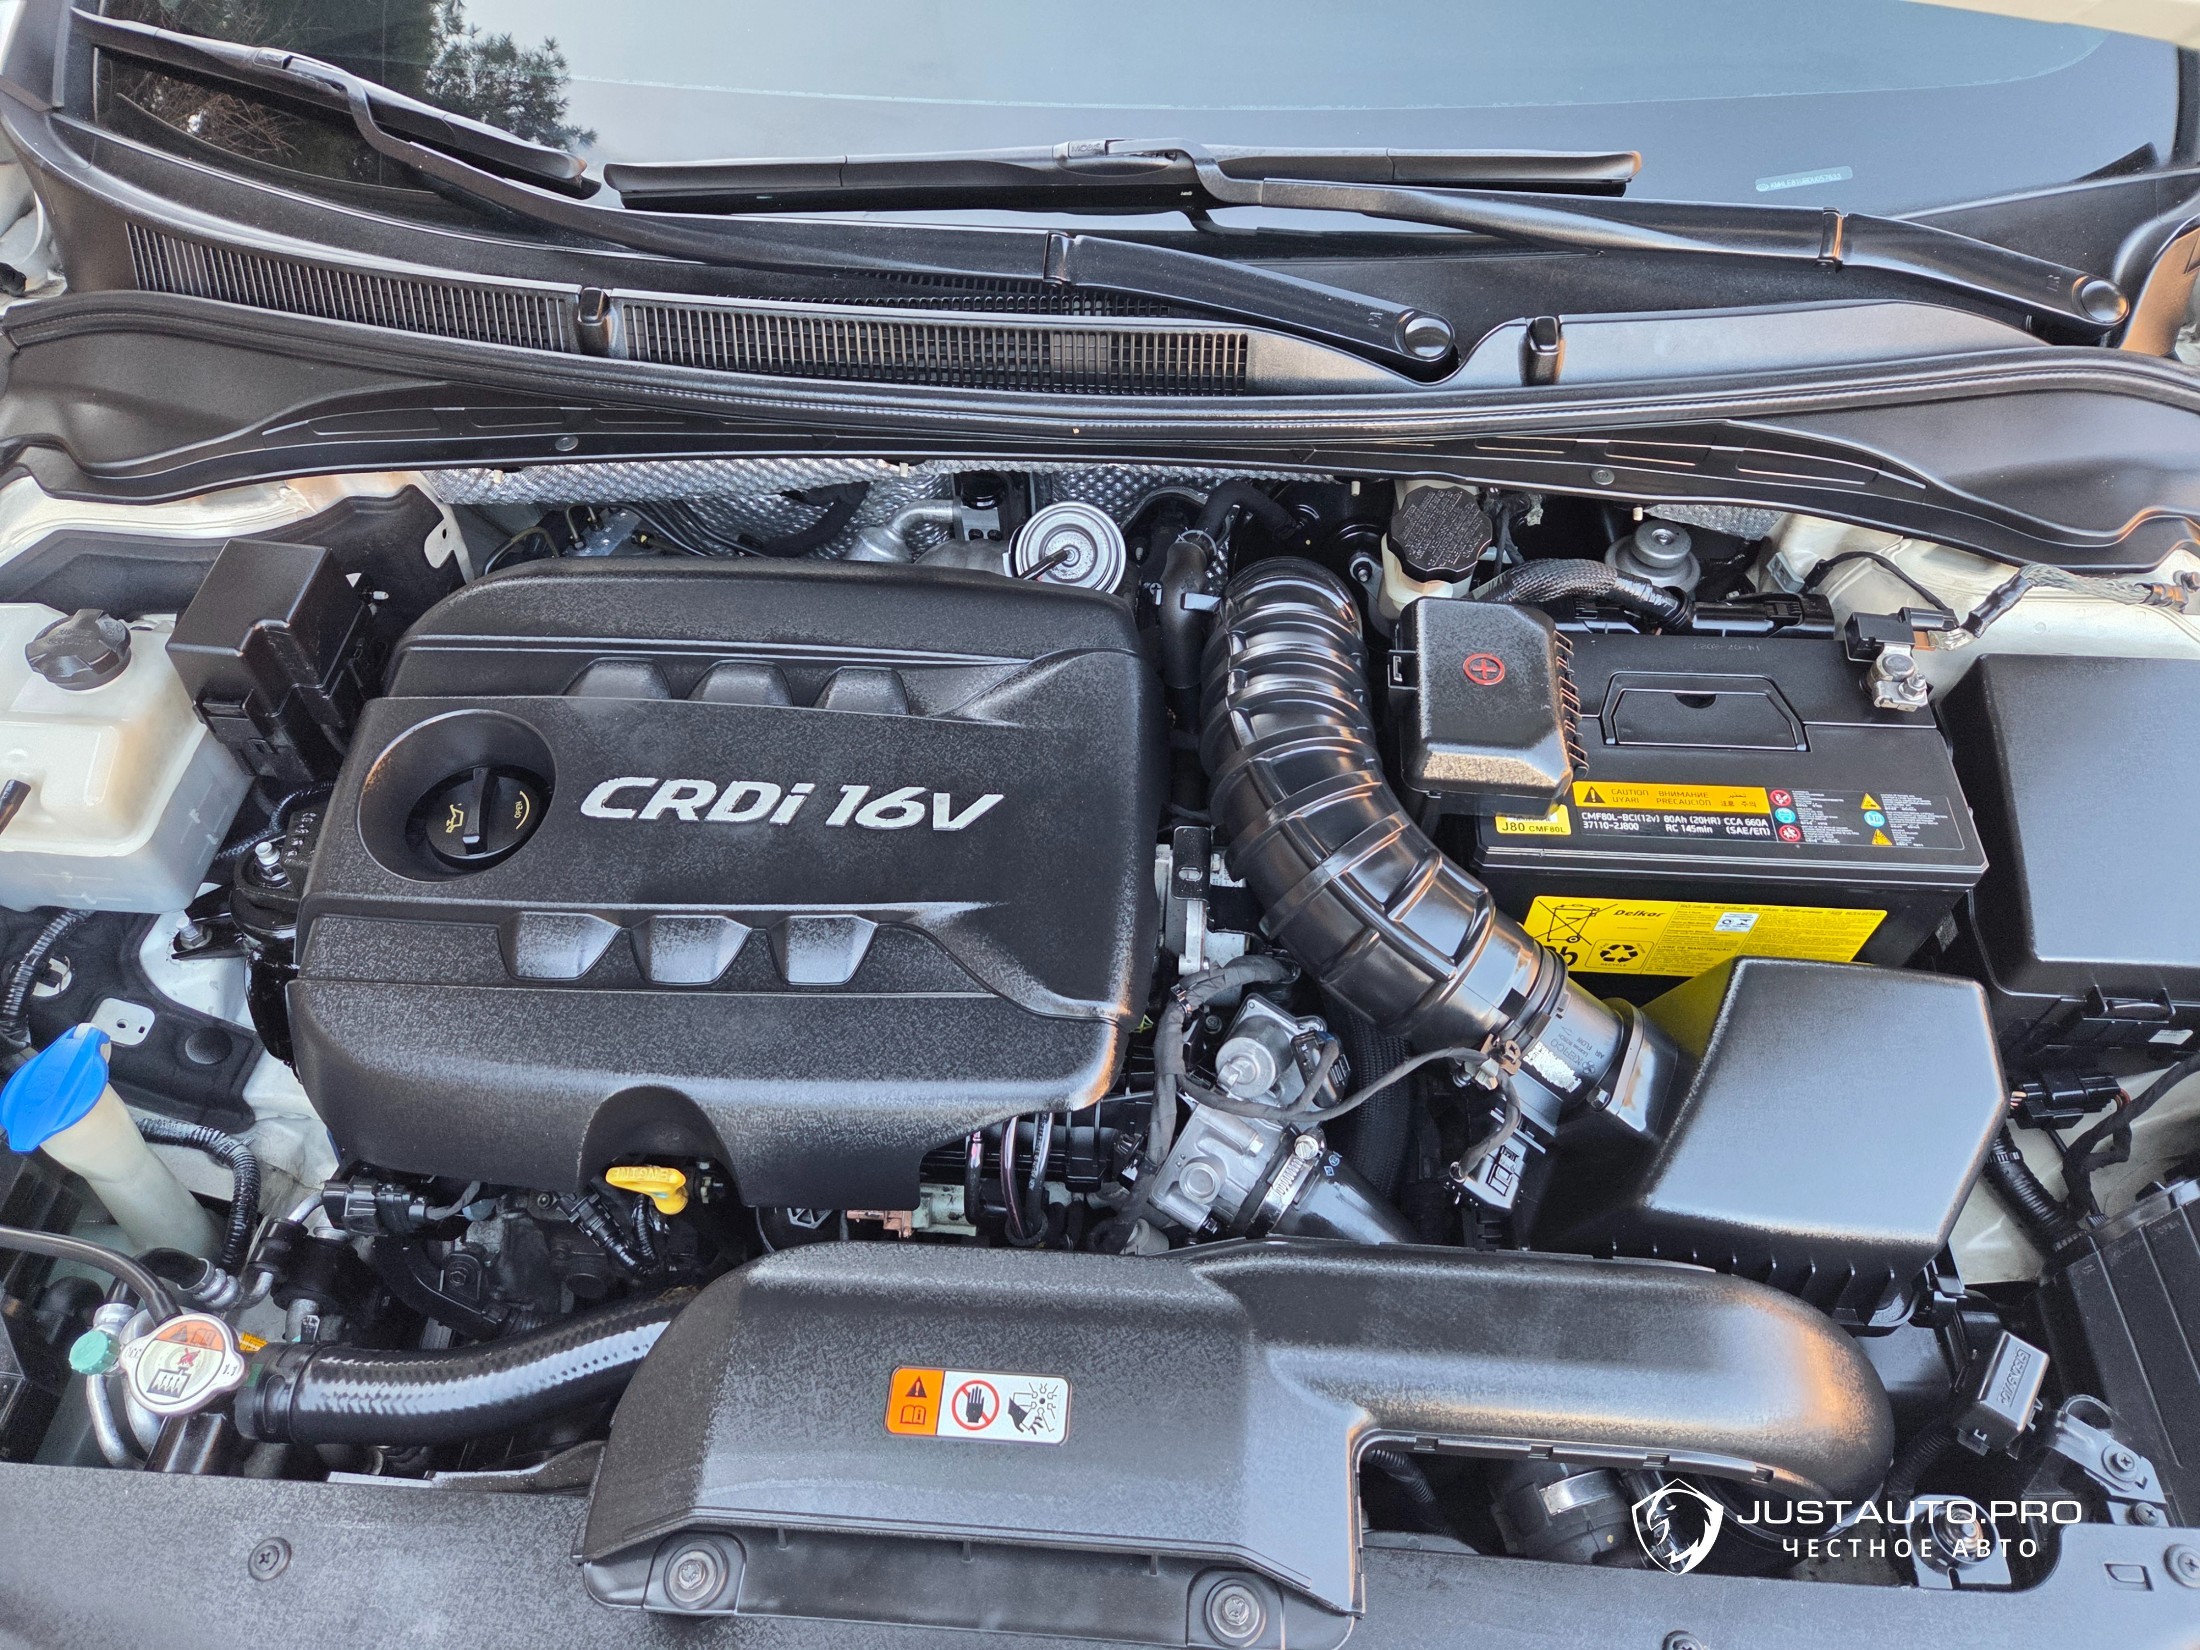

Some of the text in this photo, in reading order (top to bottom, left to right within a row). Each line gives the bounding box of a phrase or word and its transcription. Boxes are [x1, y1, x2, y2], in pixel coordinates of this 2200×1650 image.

[1611, 788, 1649, 796] CAUTION
[1658, 790, 1709, 798] ВНИМАНИЕ
[580, 776, 1004, 831] CRDi 16V
[1612, 796, 1640, 804] UYARI
[514, 800, 523, 819] OPEN
[1663, 815, 1687, 824] 80Ah
[1689, 815, 1721, 826] (20HR)
[1723, 817, 1743, 826] CCA
[1744, 818, 1769, 827] 660A
[1502, 822, 1566, 833] J80 CMF80L
[1583, 821, 1771, 836] 37110-2J800 RC 145min (SAE/EN)
[1550, 1038, 1584, 1066] KEFICO
[612, 1167, 669, 1180] ENGINE
